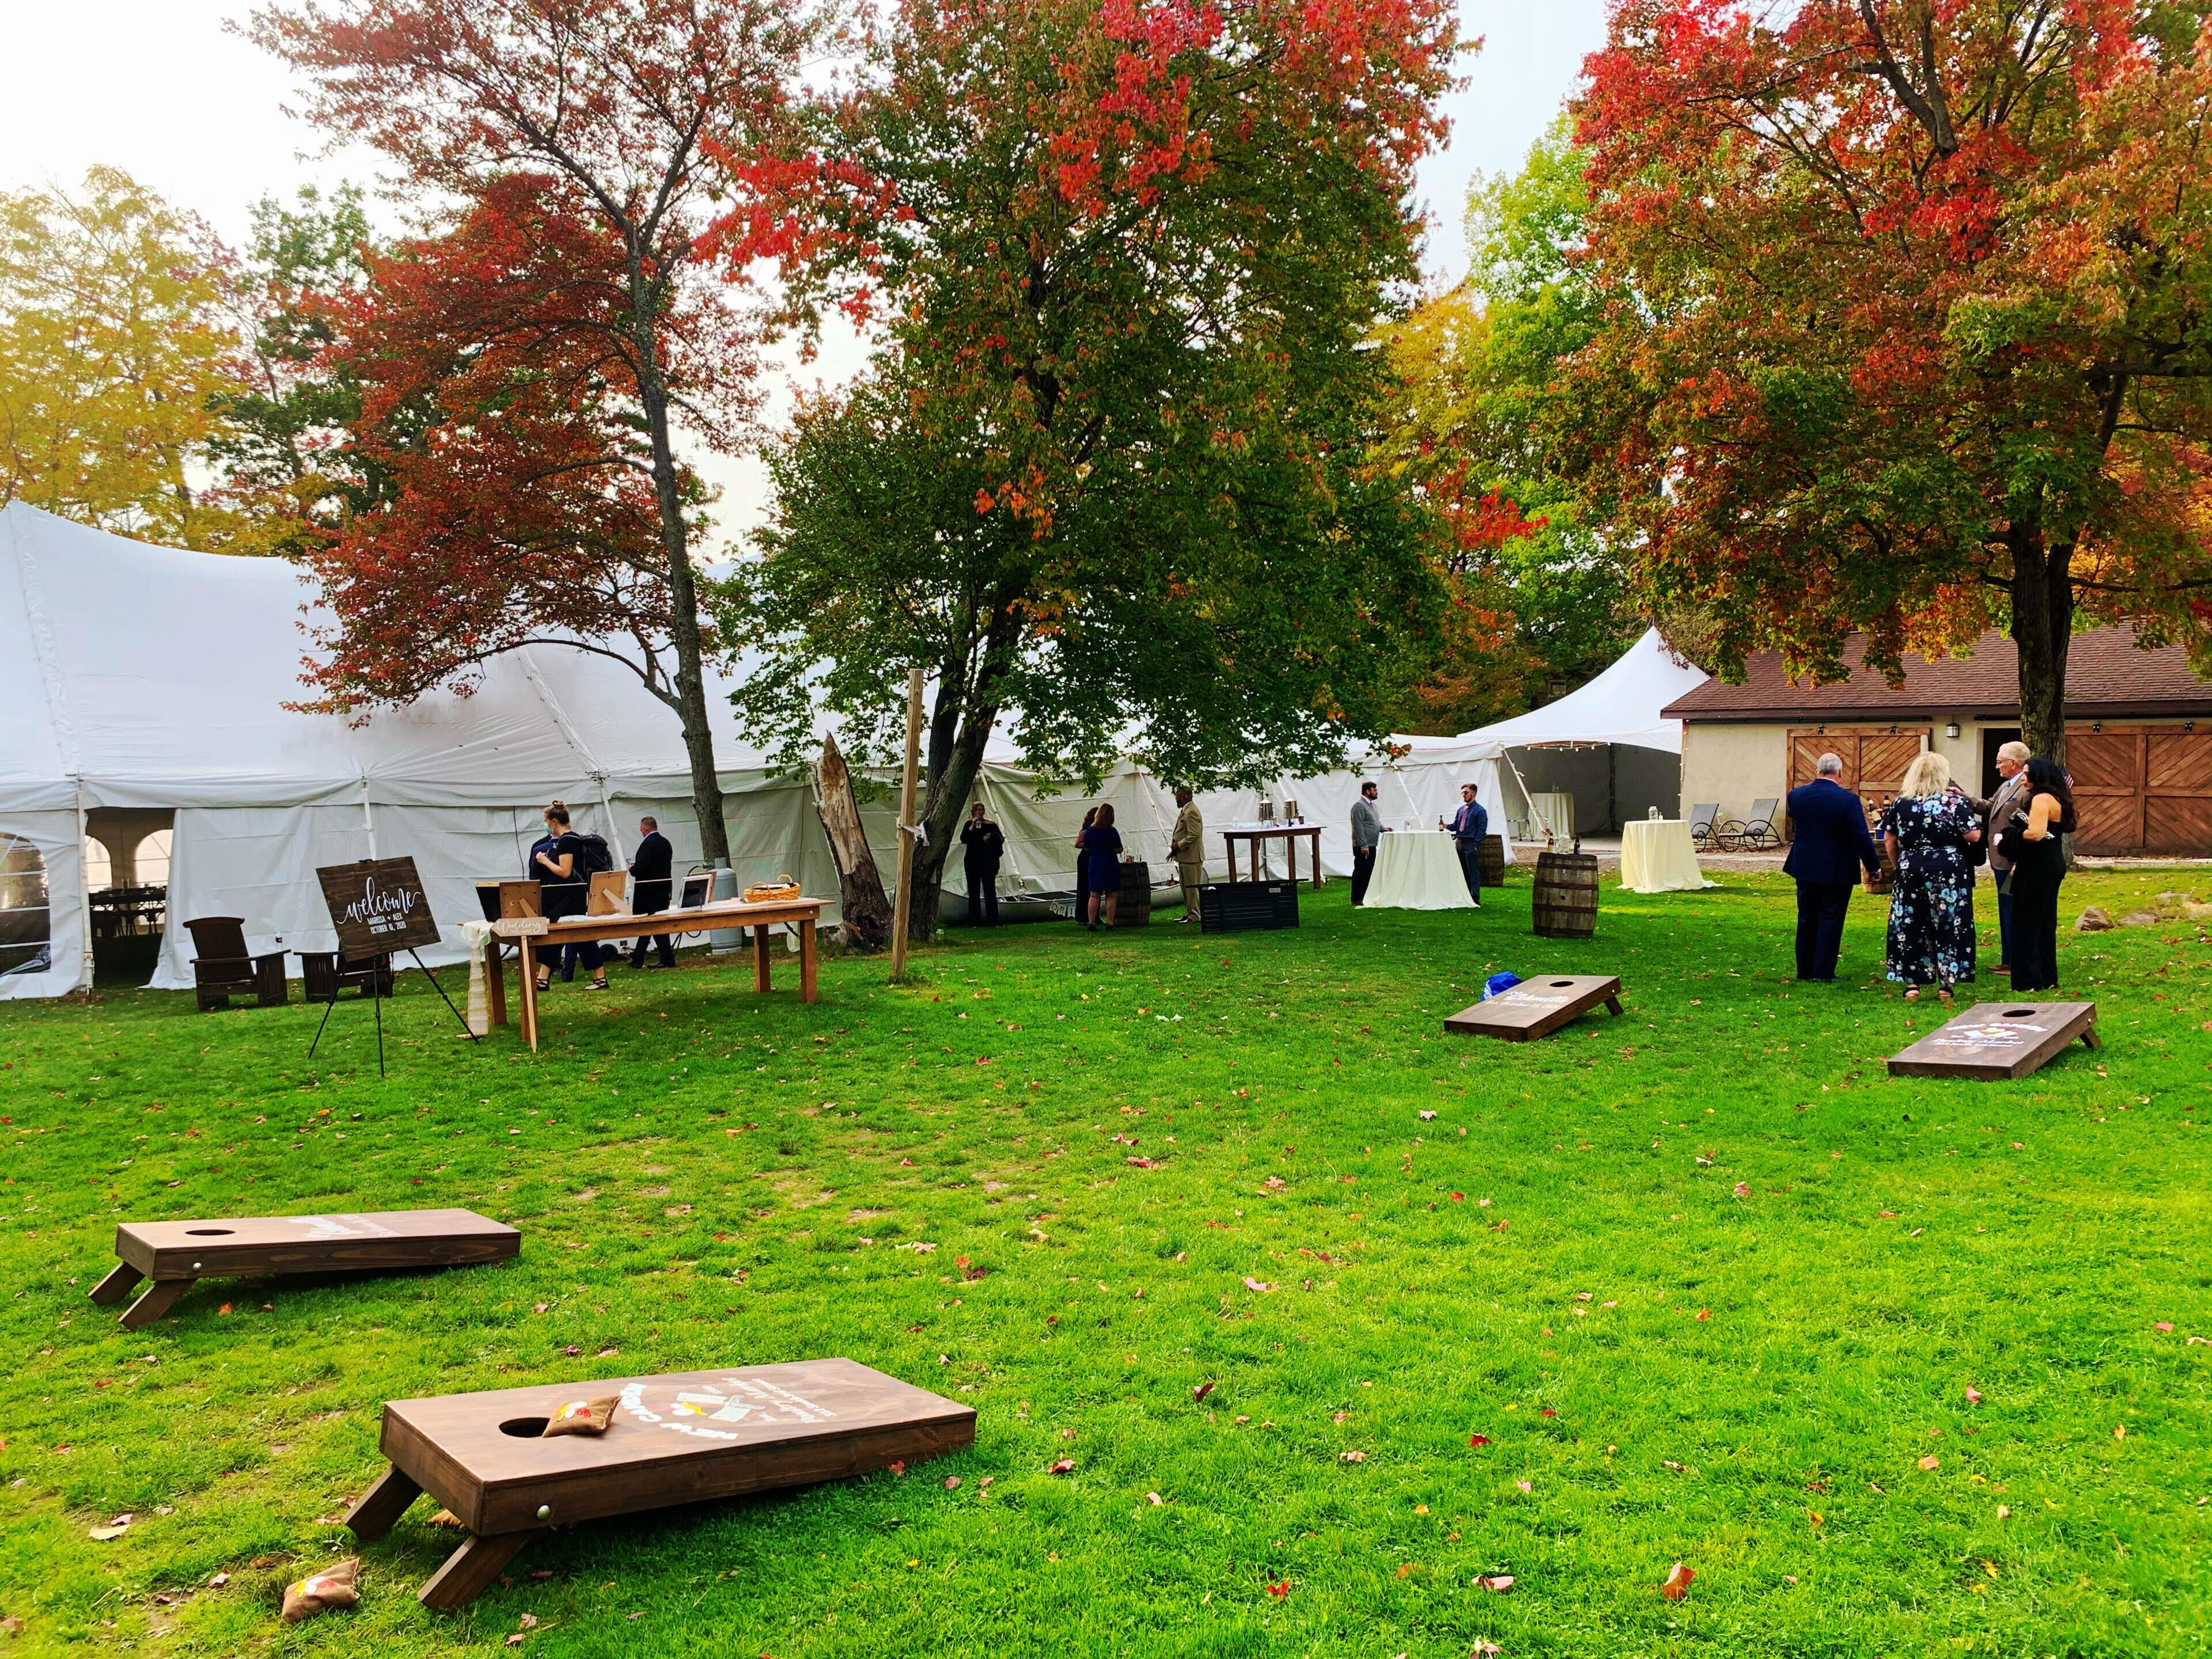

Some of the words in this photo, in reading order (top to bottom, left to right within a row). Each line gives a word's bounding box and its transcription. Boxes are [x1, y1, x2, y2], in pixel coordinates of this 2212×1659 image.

[336, 877, 421, 924] welcome
[367, 915, 387, 925] MARISSA
[392, 912, 403, 921] ALEX
[370, 924, 388, 934] OCTOBER
[395, 921, 407, 930] 2020
[497, 920, 544, 933] Wedding
[659, 1422, 738, 1440] NEW
